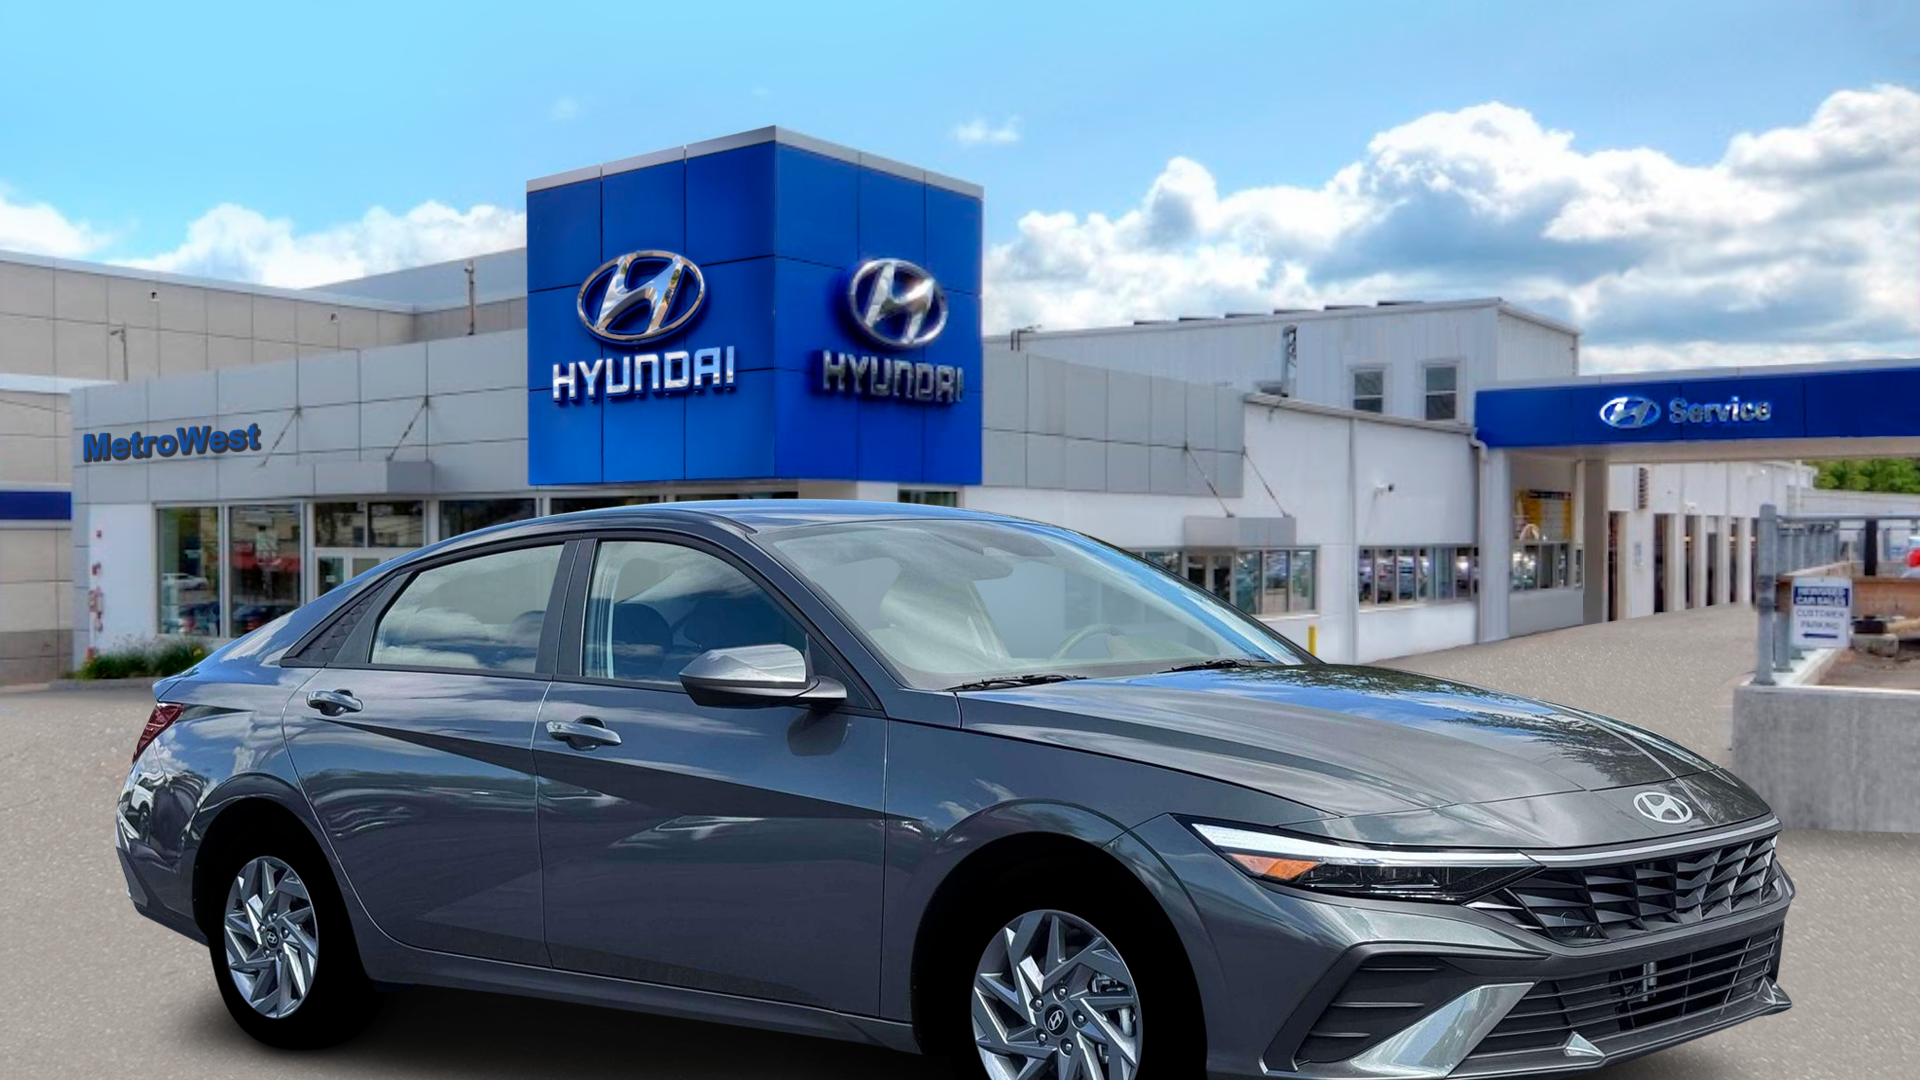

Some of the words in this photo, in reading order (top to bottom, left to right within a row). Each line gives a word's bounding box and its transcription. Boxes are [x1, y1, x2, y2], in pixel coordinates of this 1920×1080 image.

[553, 346, 735, 400] HYUNDAI
[822, 350, 964, 403] HYUNDAI
[1668, 395, 1772, 425] Service
[83, 423, 262, 463] MetroWest
[1795, 596, 1817, 606] CAR
[1796, 609, 1845, 618] CUSTOMER
[1800, 620, 1840, 630] PARKING
